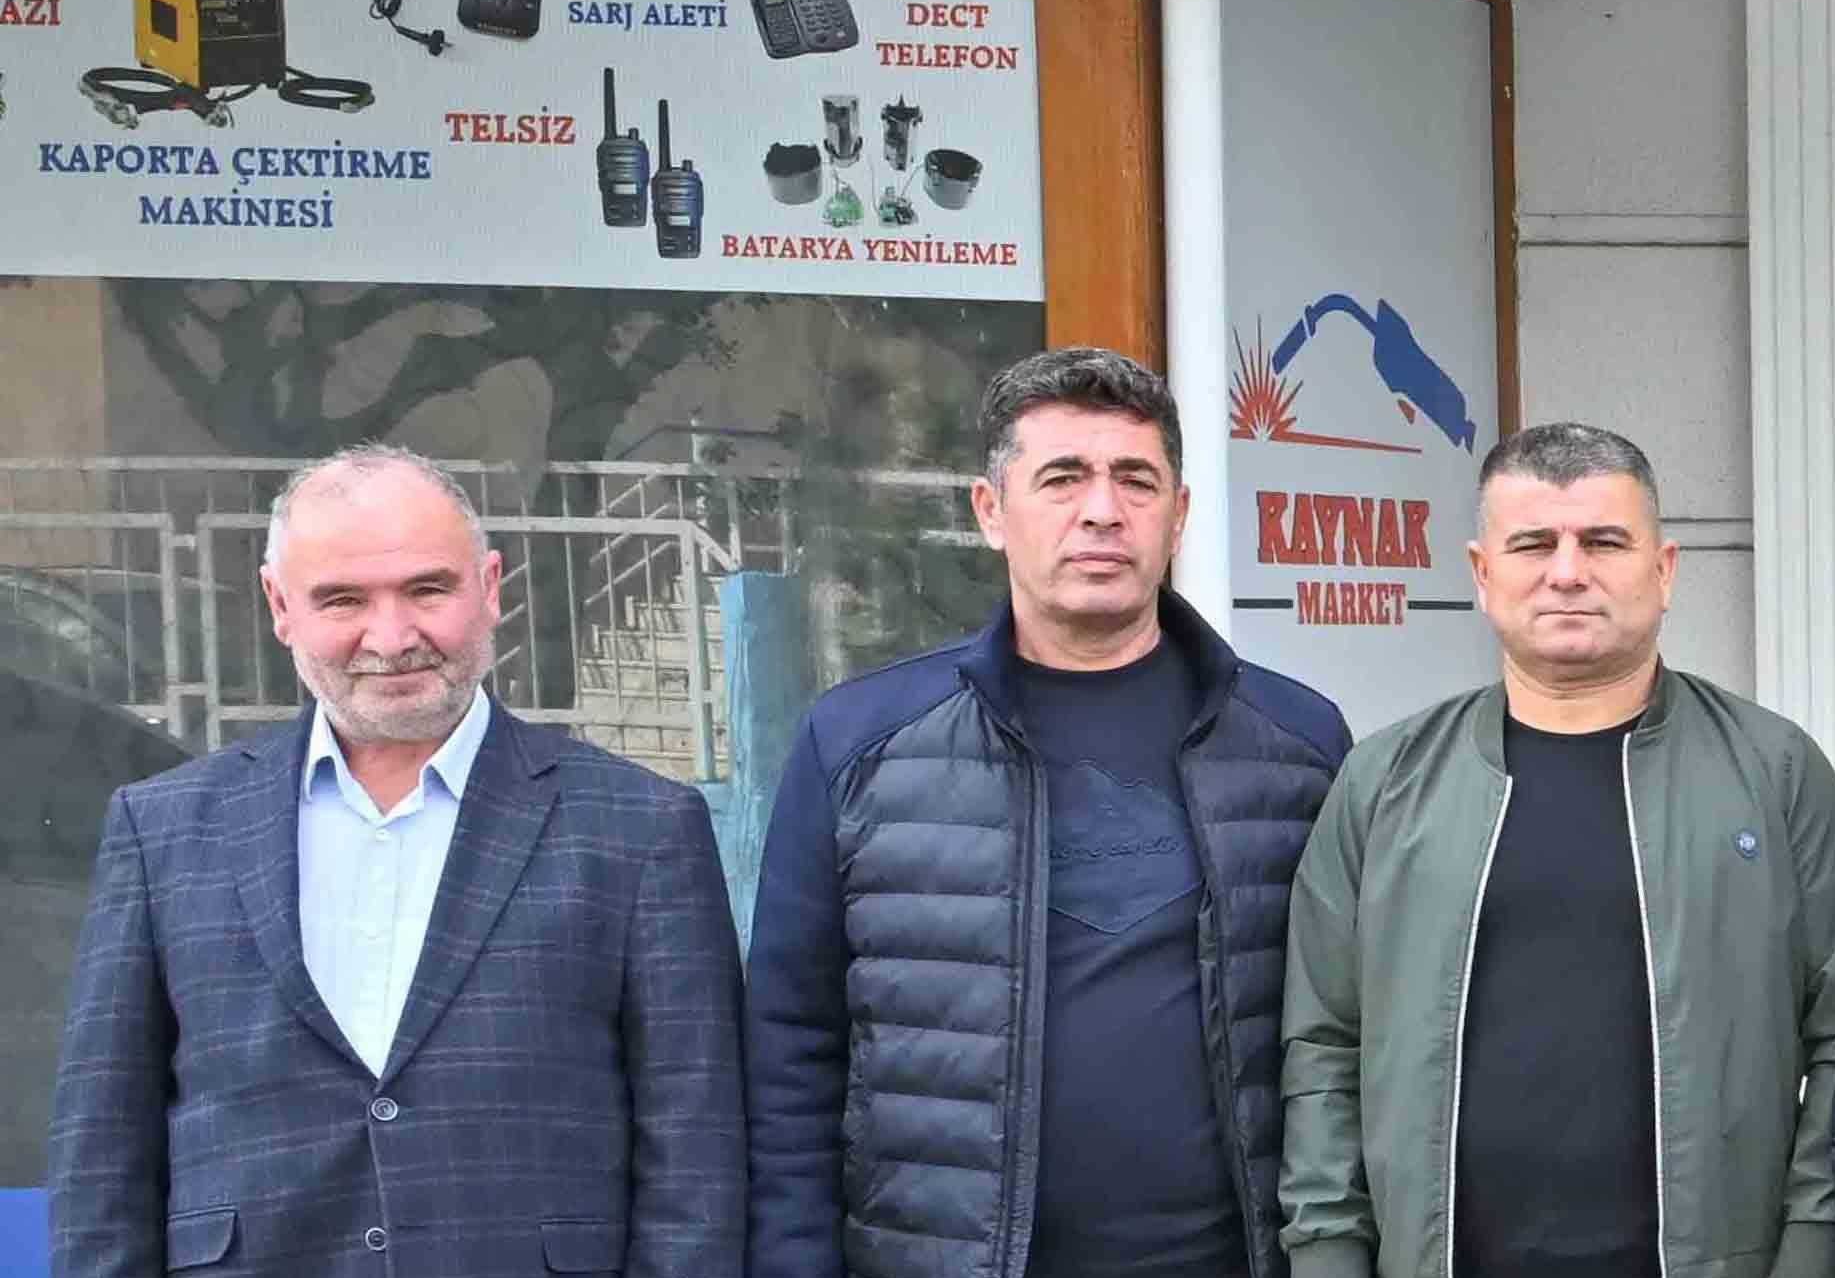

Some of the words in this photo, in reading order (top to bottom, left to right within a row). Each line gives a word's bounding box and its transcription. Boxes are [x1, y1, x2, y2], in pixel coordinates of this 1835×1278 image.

[568, 1, 633, 30] SARJ
[907, 3, 990, 28] DECT
[876, 42, 1019, 70] TELEFON
[445, 106, 576, 145] TELSİZ
[39, 143, 220, 176] KAPORTA
[232, 140, 431, 184] ÇEKTİRME
[139, 188, 334, 228] MAKİNESİ
[722, 234, 854, 260] BATARYA
[863, 233, 1018, 266] YENİLEME
[1257, 490, 1431, 569] KAYNAK
[1296, 580, 1407, 626] MARKET
